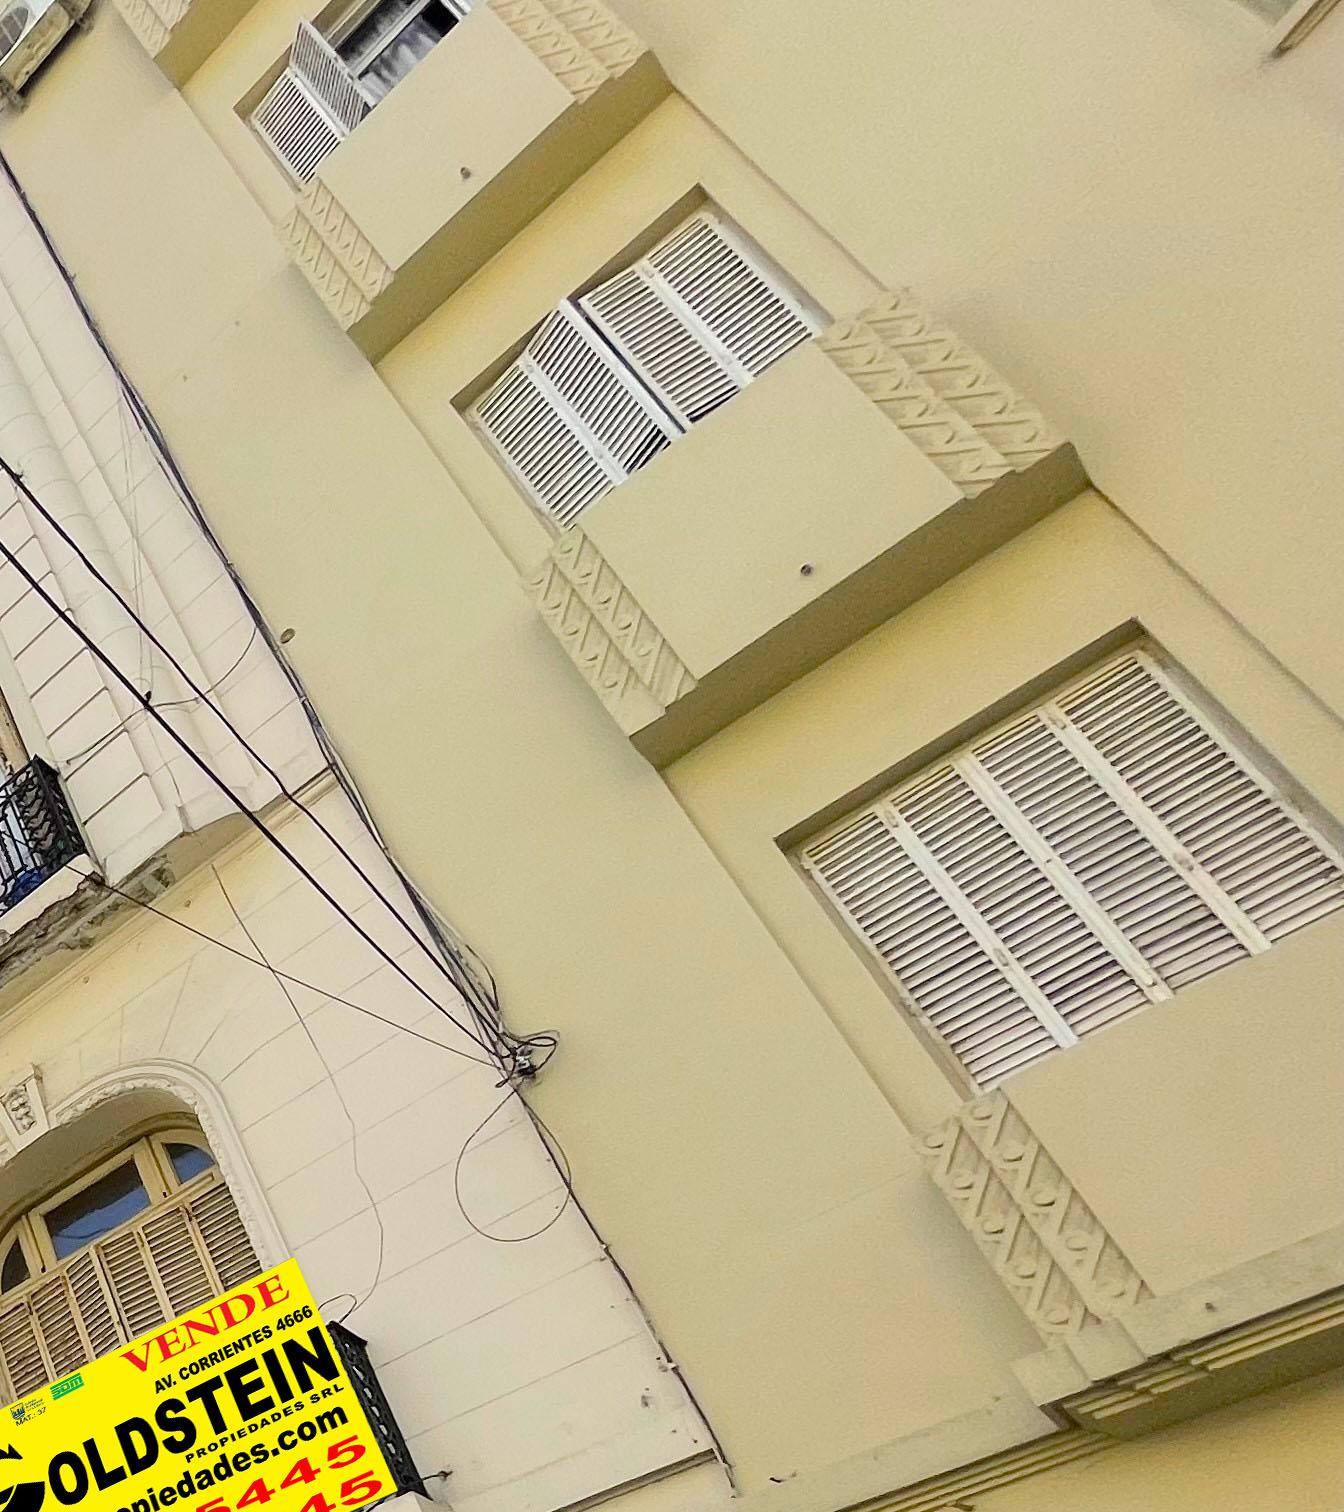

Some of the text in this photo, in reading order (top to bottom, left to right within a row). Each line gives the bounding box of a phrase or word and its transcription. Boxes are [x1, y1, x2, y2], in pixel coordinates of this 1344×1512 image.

[120, 1275, 290, 1372] VENDE
[154, 1304, 313, 1394] AV. CORRIENTES 4666
[185, 1383, 345, 1463] PROPIEDADES SRL
